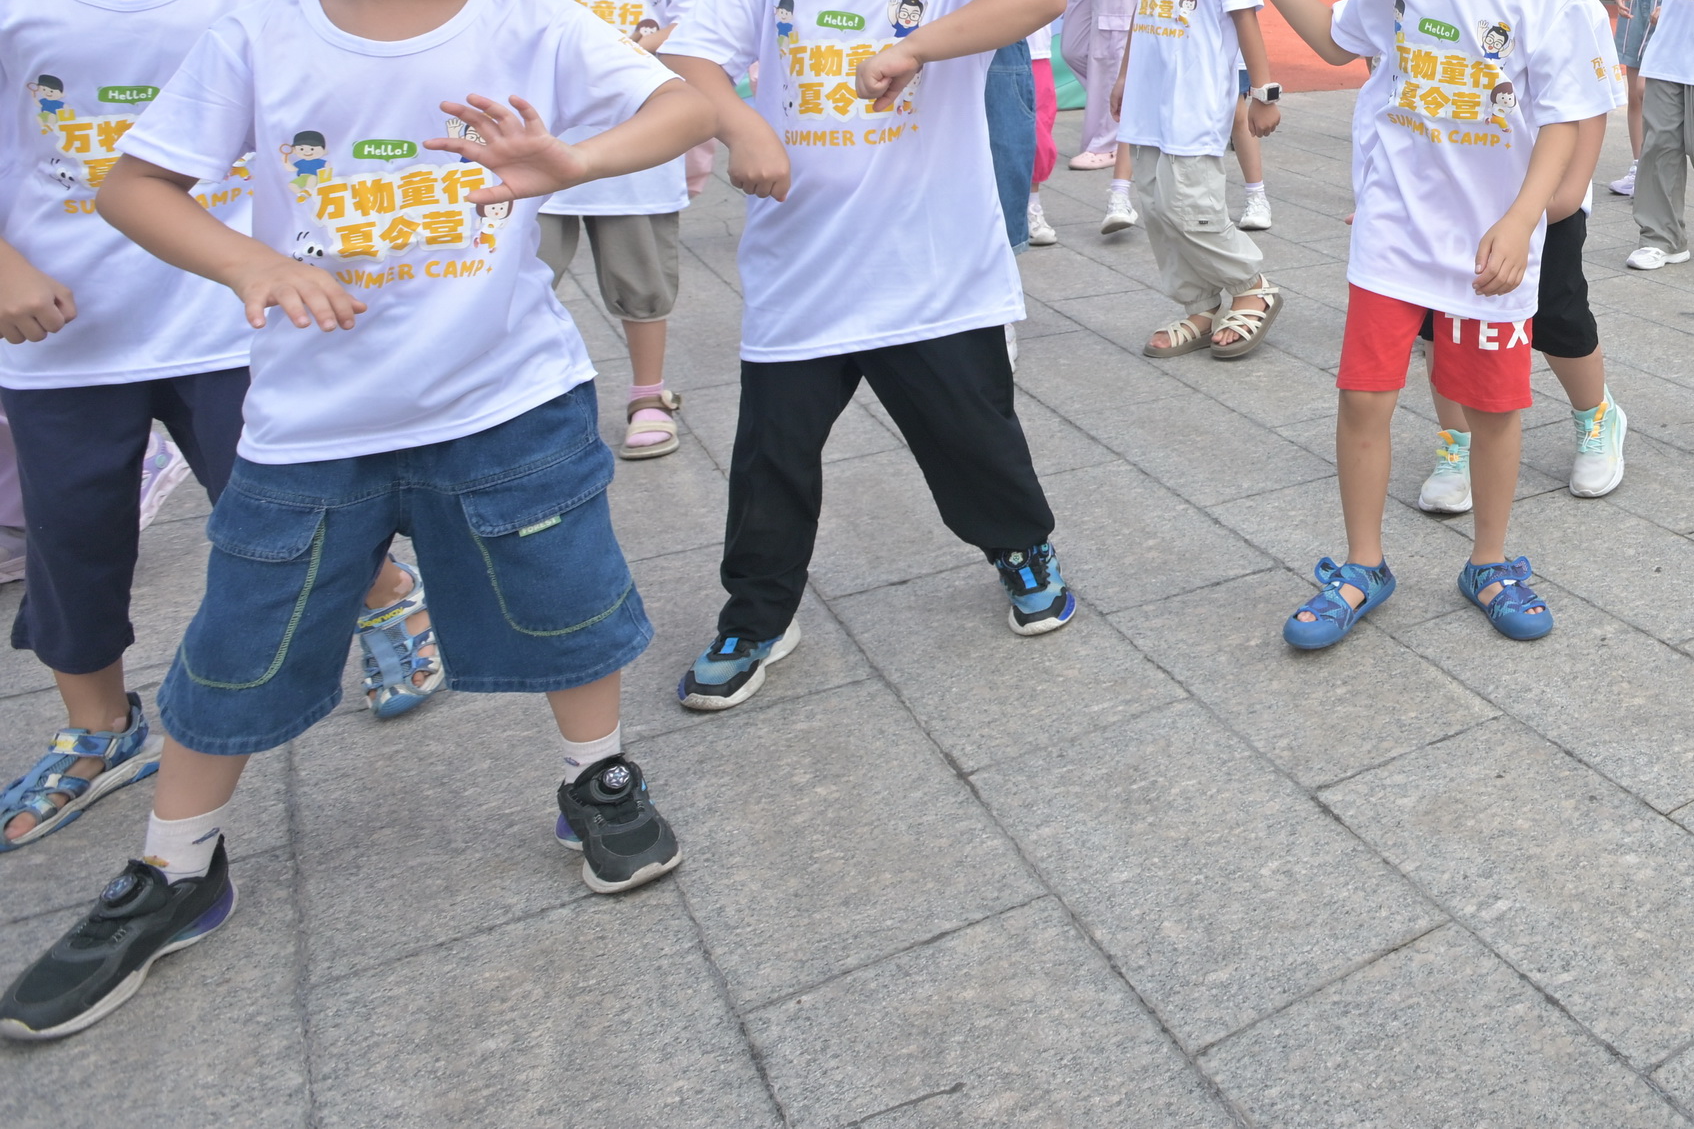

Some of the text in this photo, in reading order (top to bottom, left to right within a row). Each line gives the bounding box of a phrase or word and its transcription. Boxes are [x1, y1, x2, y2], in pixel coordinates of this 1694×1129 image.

[823, 14, 859, 27] Hello!
[1424, 21, 1455, 39] Hello!
[1396, 45, 1500, 90] 万物童行
[108, 88, 153, 100] Hello!
[1398, 80, 1482, 120] 夏令营
[363, 142, 409, 156] Hello!
[784, 129, 856, 147] SUMMER
[1447, 129, 1501, 147] CAMP
[316, 167, 486, 221] 万物童行
[335, 210, 465, 259] 夏令营
[336, 259, 486, 290] UMMER CAMP
[1444, 312, 1530, 351] TEX
